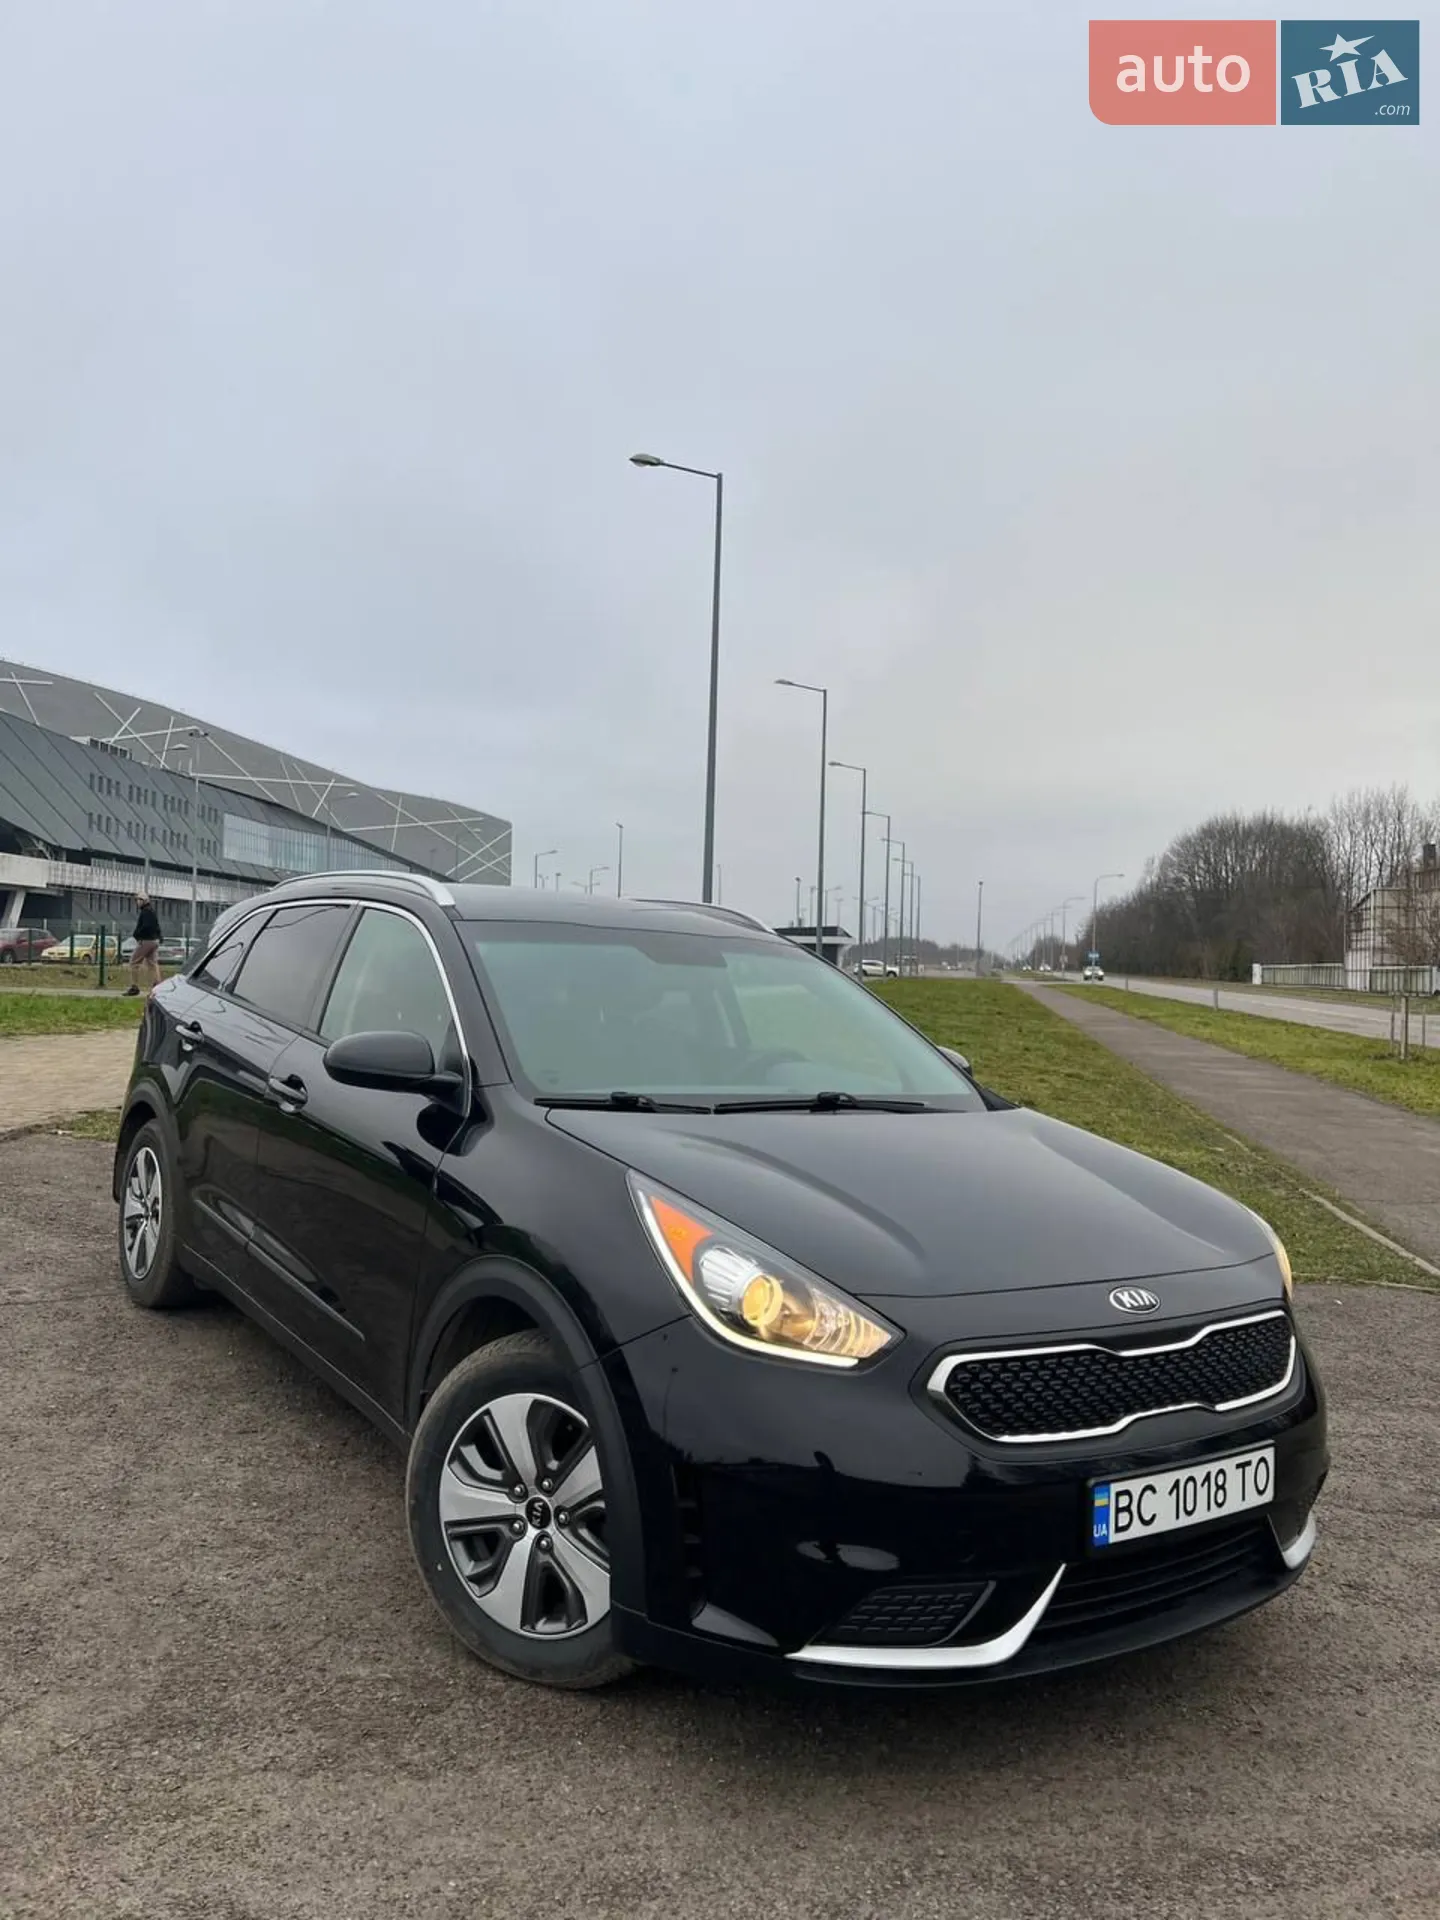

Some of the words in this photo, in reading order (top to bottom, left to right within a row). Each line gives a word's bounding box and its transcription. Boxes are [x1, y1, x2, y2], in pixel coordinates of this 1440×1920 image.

[1115, 1288, 1157, 1308] KIA
[1114, 1483, 1157, 1534] BC
[1168, 1468, 1227, 1521] 1018
[1235, 1456, 1270, 1502] TO
[1093, 1523, 1108, 1537] UA
